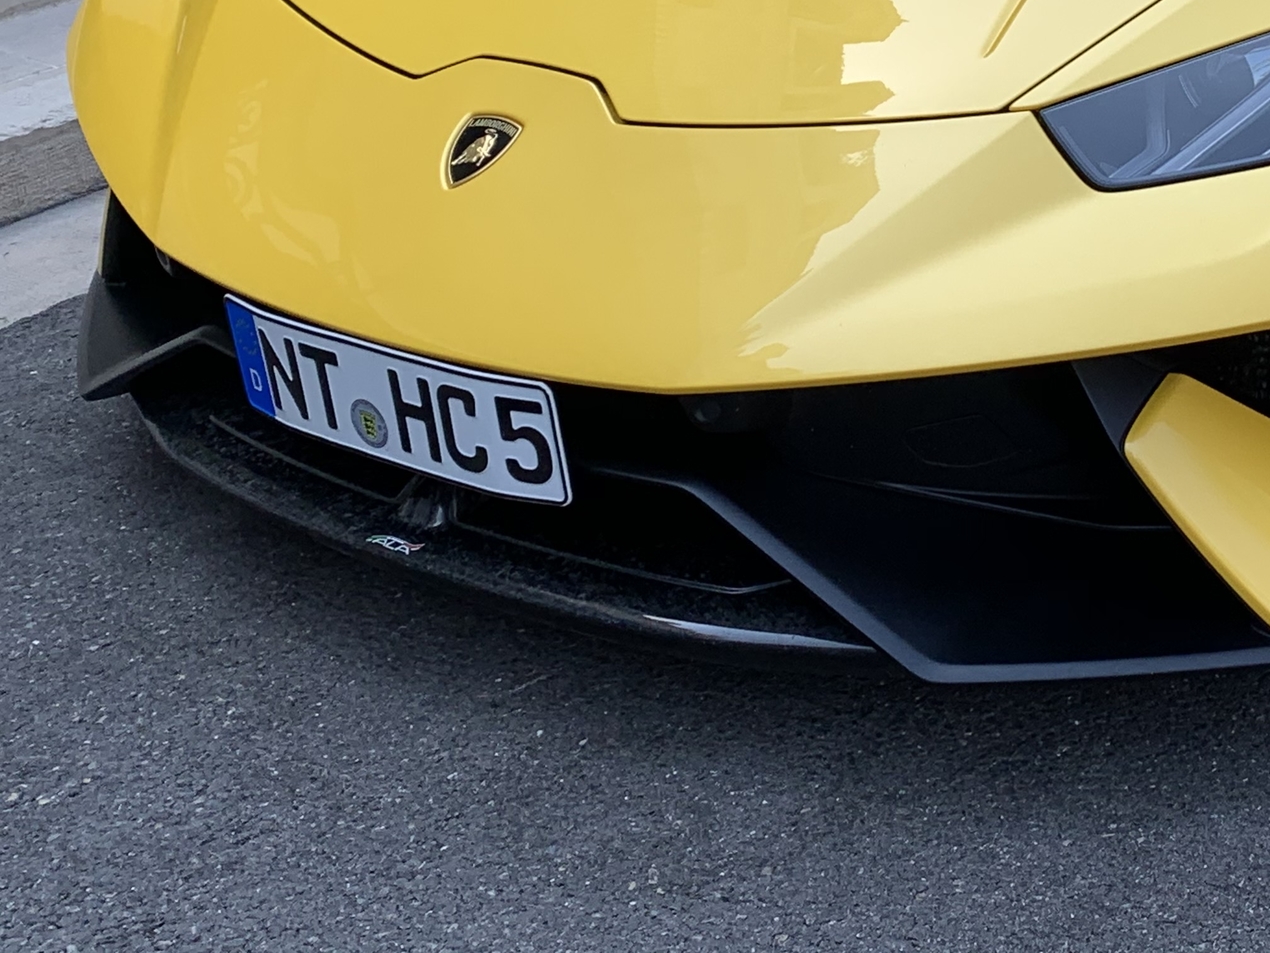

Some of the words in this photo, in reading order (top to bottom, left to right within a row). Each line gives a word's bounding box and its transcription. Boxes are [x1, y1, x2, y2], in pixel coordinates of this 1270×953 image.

[249, 368, 263, 391] D
[258, 327, 339, 430] NT
[386, 368, 489, 474] HC
[494, 395, 554, 485] 5
[372, 537, 410, 556] ALA
